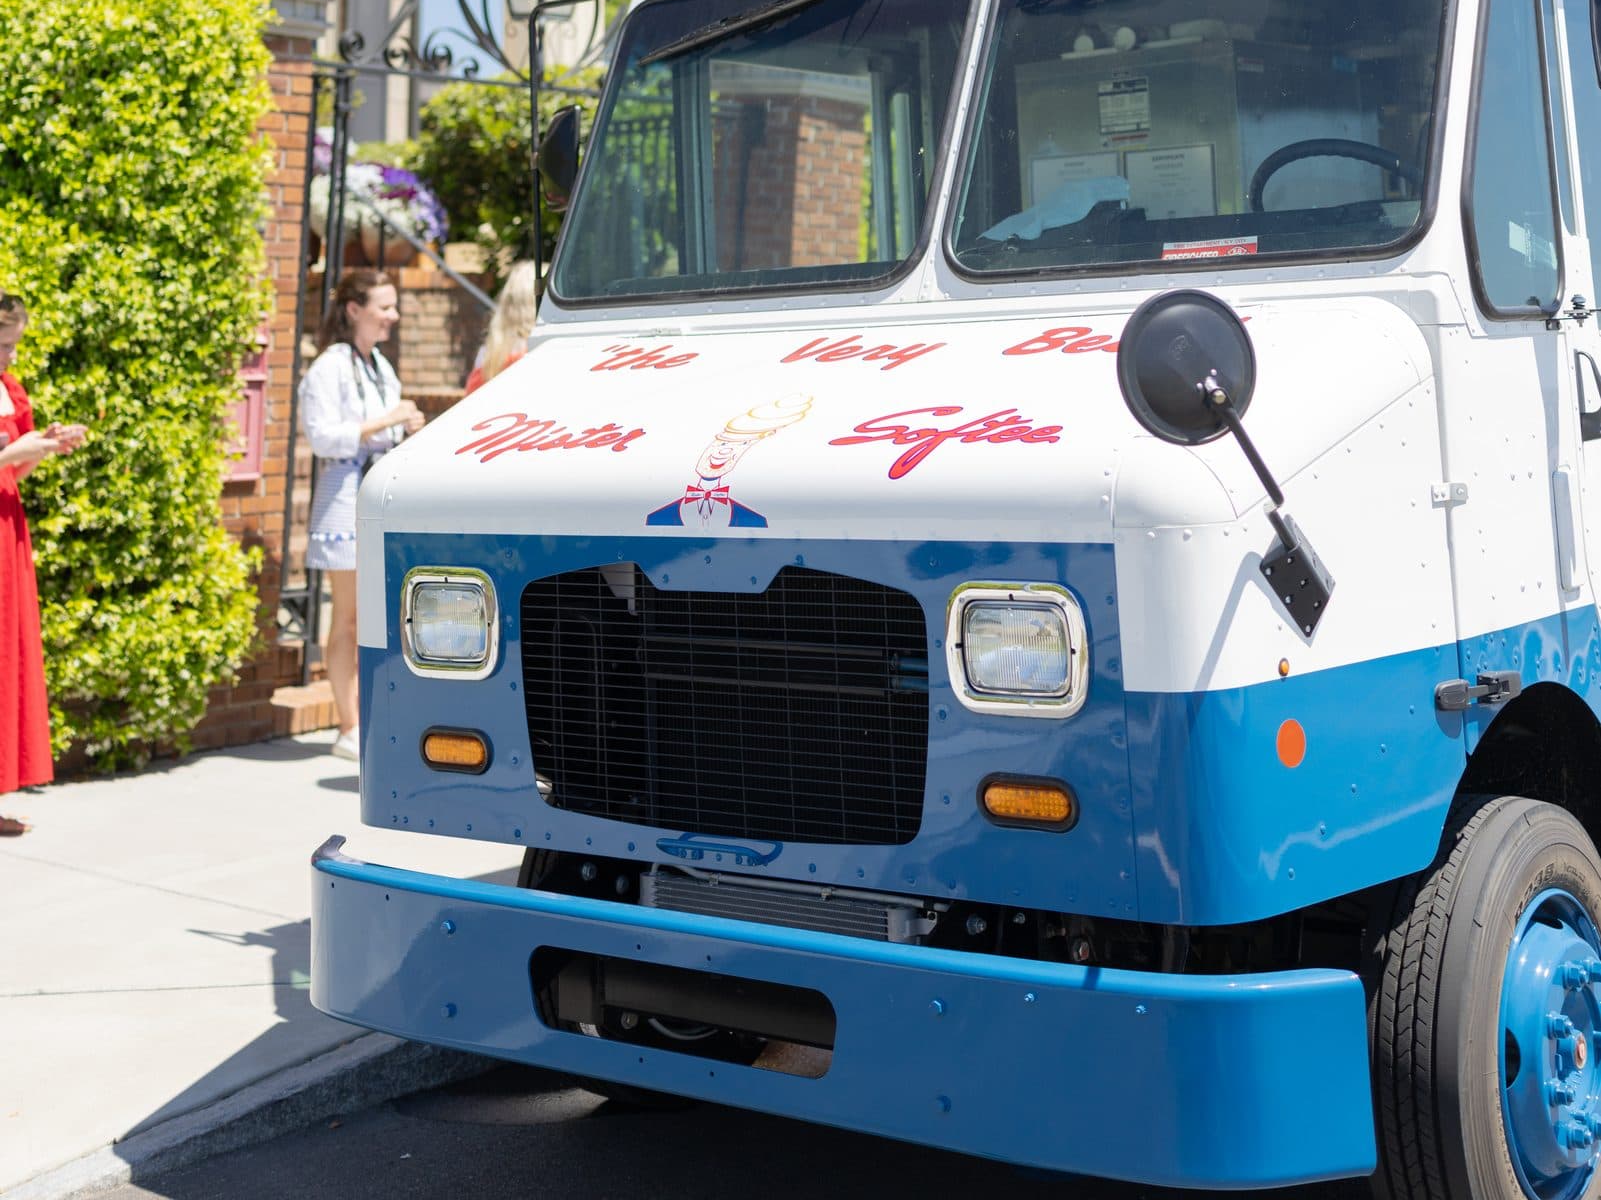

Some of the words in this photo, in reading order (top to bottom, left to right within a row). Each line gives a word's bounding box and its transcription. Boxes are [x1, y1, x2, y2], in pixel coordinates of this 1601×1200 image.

[780, 335, 947, 371] Very
[1002, 326, 1119, 355] Be
[455, 413, 646, 463] Mister
[828, 406, 1063, 480] Softee
